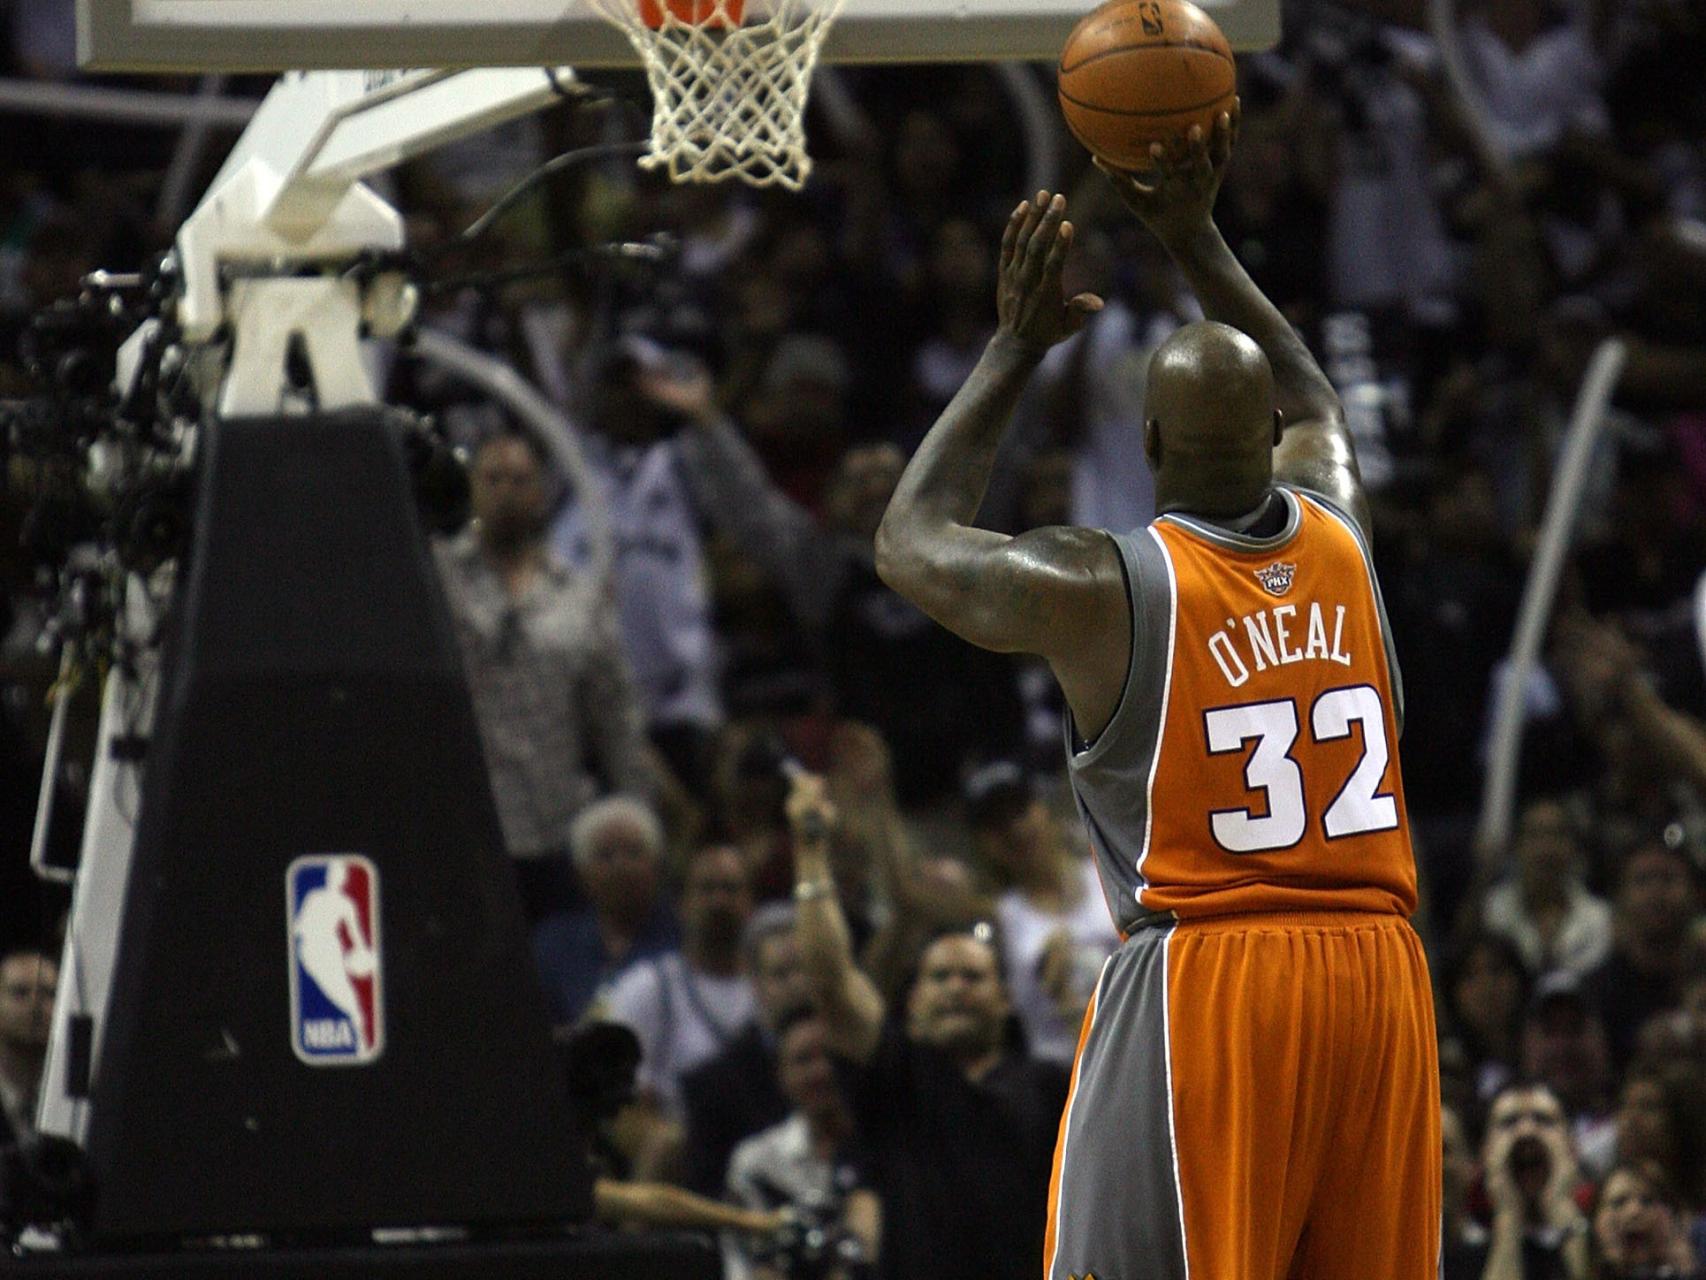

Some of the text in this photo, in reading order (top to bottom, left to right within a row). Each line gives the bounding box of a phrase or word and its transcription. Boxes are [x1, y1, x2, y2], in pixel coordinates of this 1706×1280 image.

[1266, 576, 1288, 588] PHX
[1208, 602, 1351, 687] O'NEAL
[1202, 683, 1398, 855] 32
[304, 1019, 352, 1048] NBA
